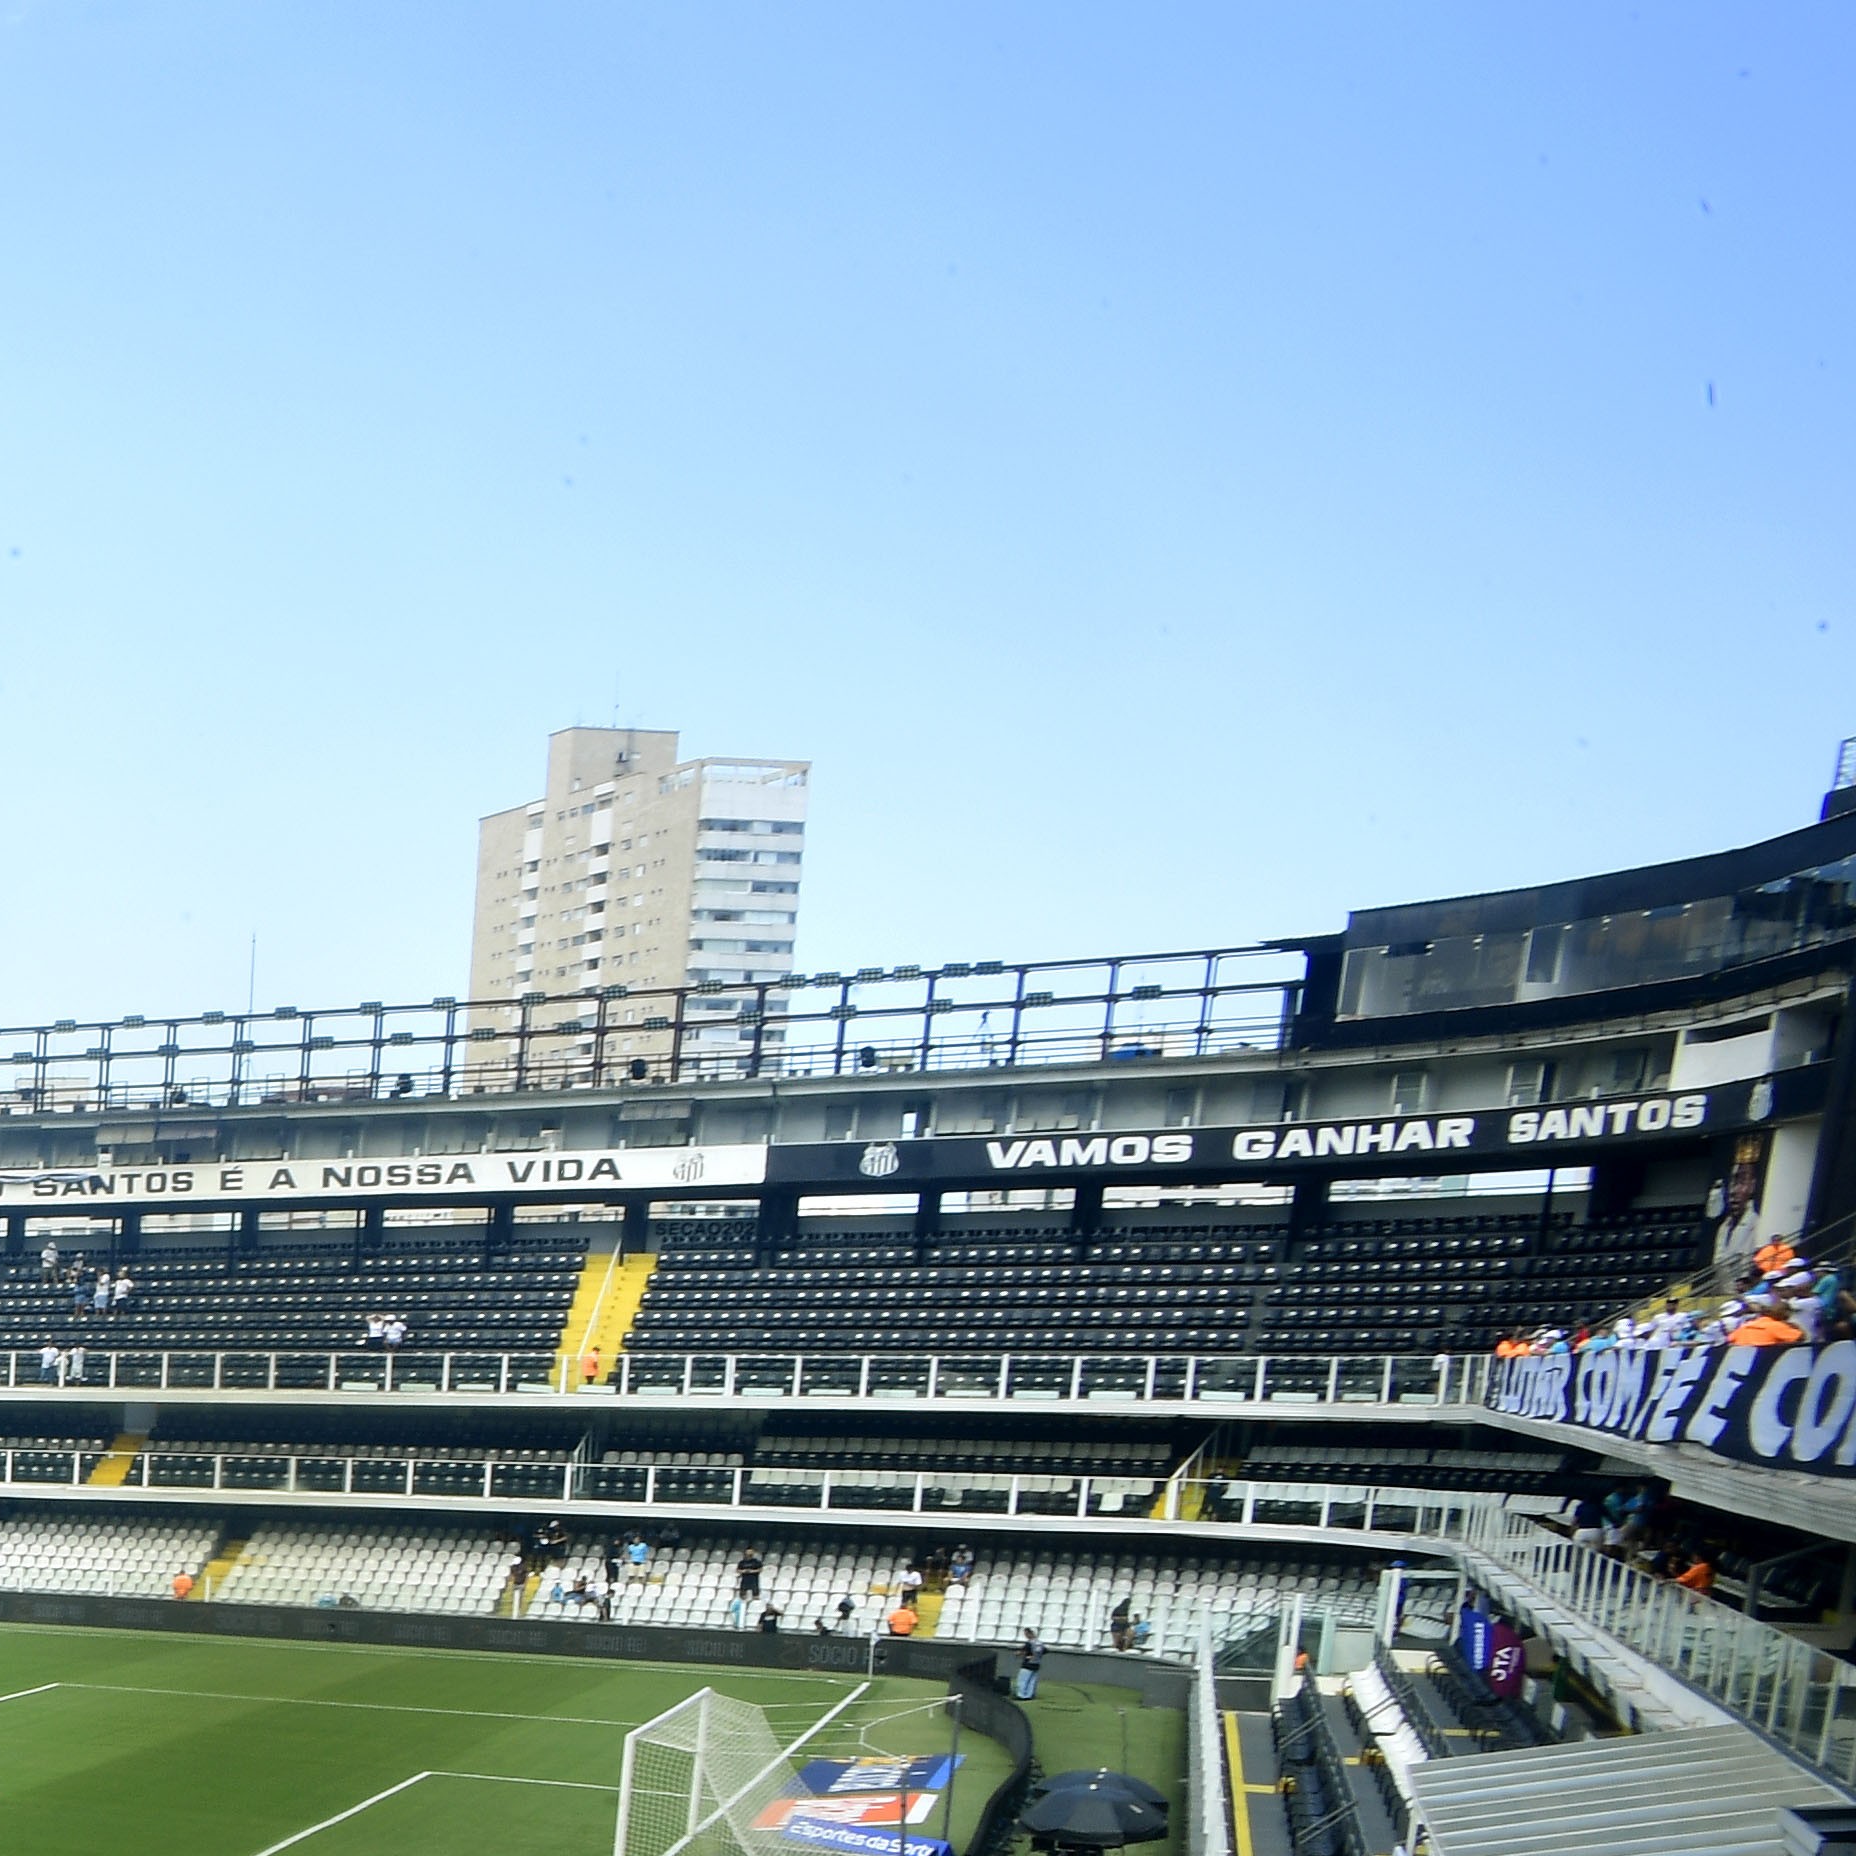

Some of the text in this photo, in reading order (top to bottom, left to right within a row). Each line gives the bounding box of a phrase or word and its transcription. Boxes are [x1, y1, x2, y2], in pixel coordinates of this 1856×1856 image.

[986, 1094, 1708, 1169] VAMOS GANHAR SANTOS
[33, 1171, 194, 1197] SANTOS
[221, 1165, 244, 1191] É
[269, 1168, 298, 1189] A
[322, 1163, 476, 1188] NOSSA
[506, 1158, 622, 1183] VIDA
[1496, 1354, 1572, 1422] LUTAR
[1575, 1349, 1647, 1432] COM
[1685, 1345, 1759, 1447] E
[1749, 1339, 1856, 1466] CO
[789, 1820, 865, 1846] Esportes
